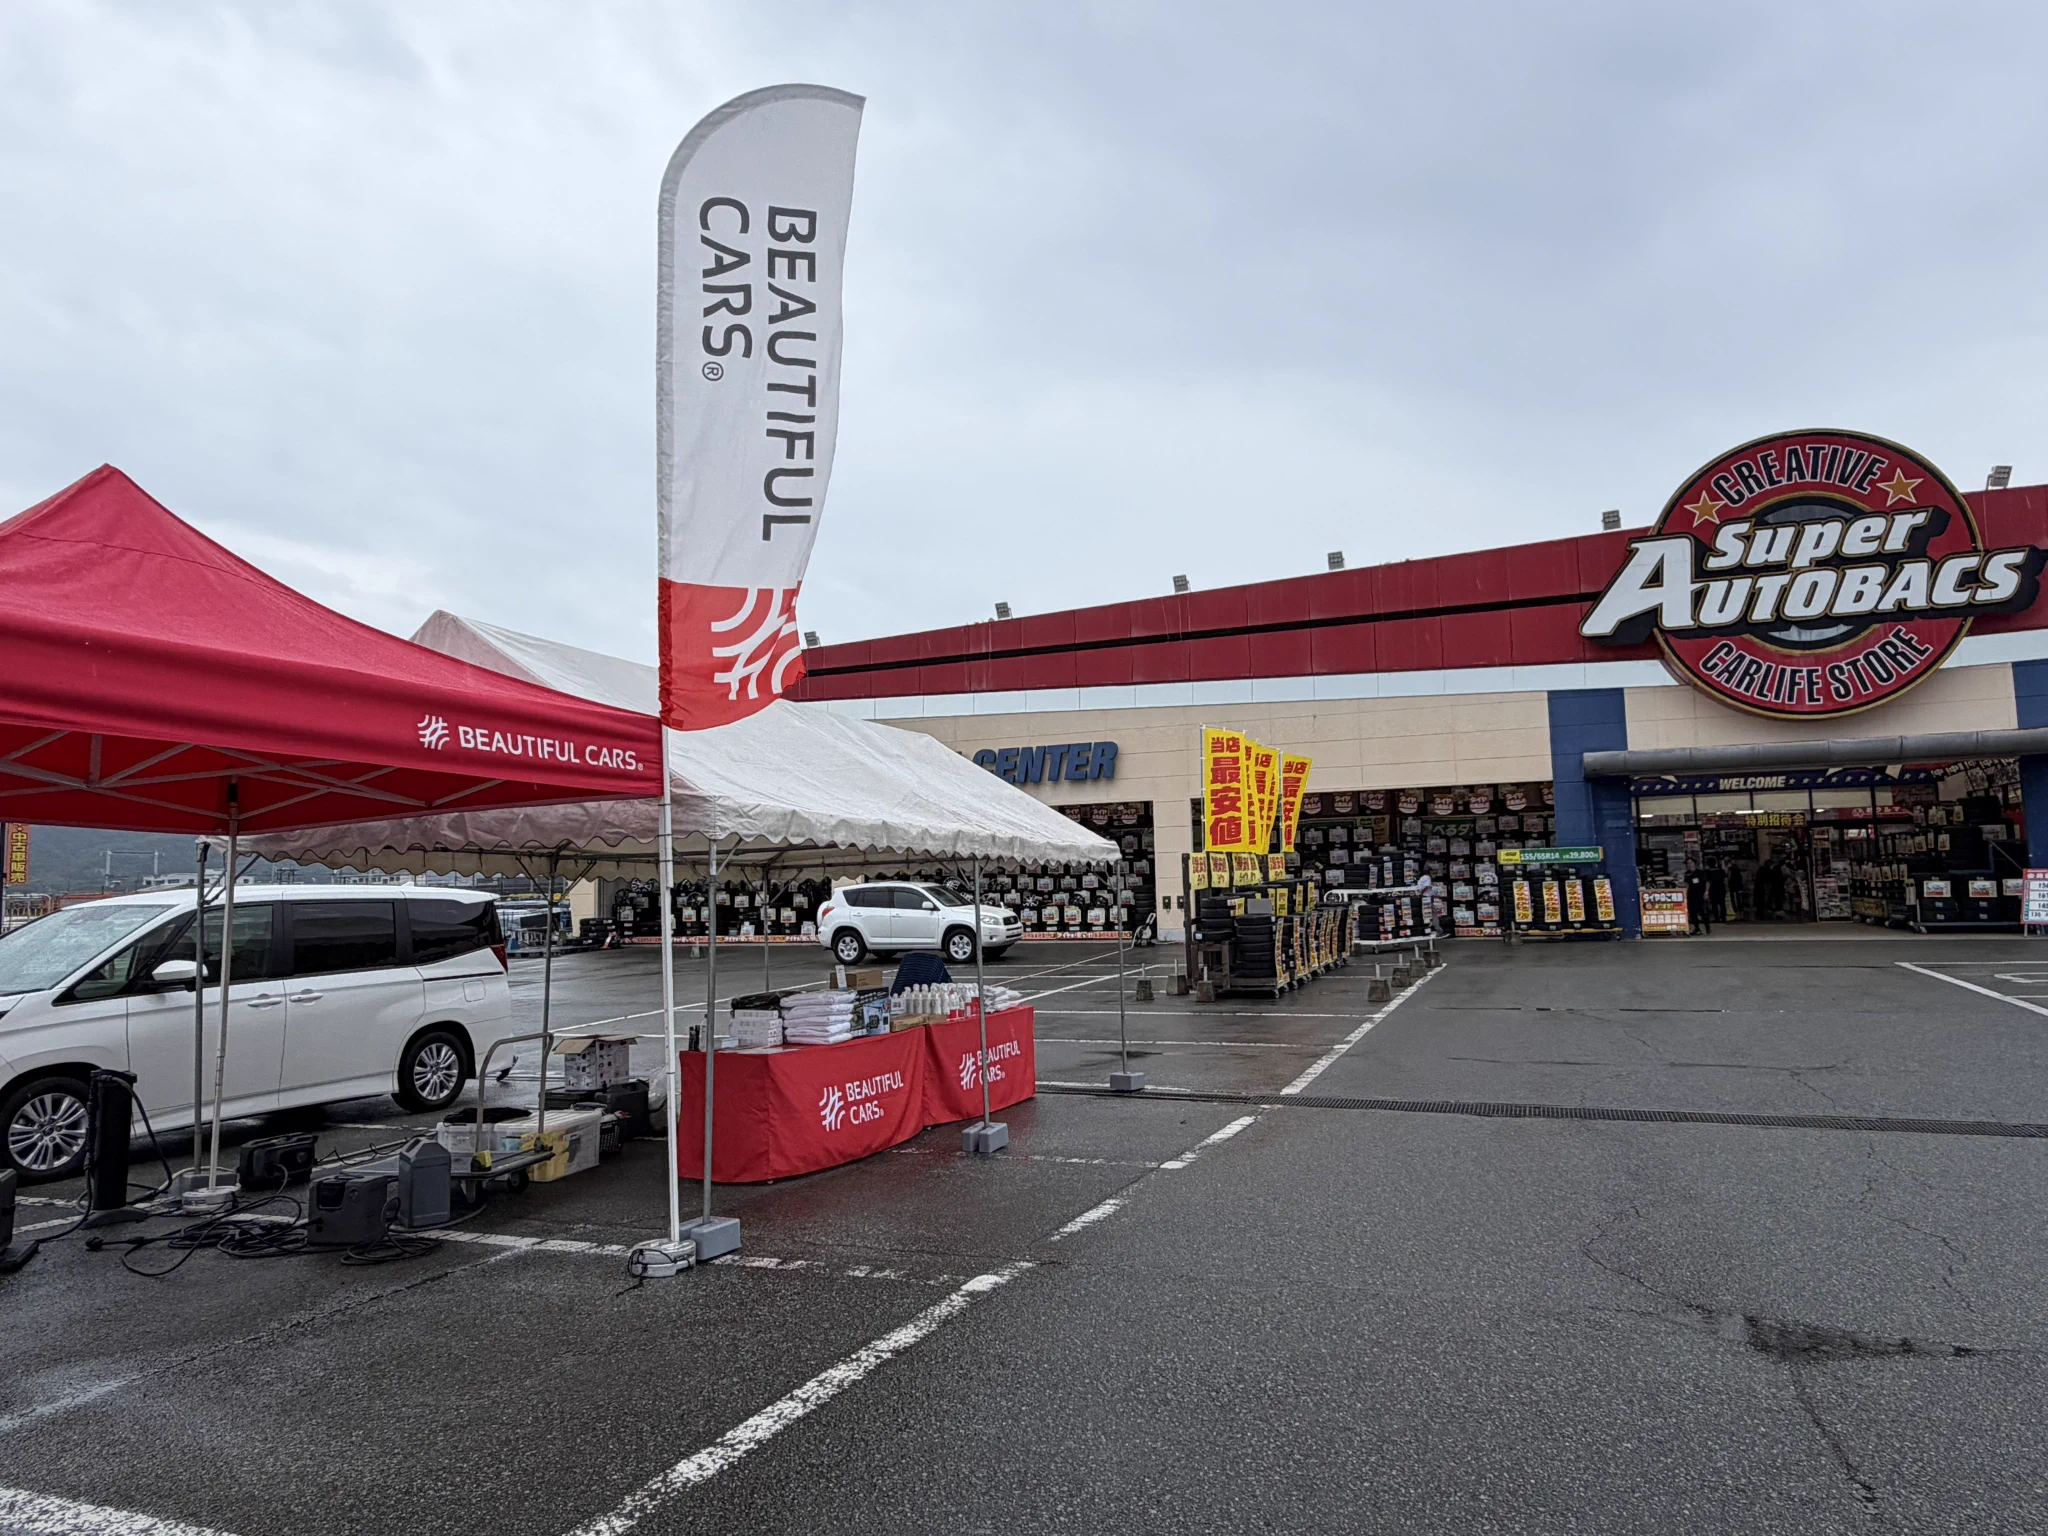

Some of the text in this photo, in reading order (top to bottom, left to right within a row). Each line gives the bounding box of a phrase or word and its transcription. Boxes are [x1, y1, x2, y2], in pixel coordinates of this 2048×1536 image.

[763, 204, 818, 542] BEAUTIFUL
[1711, 445, 1889, 506] CREATIVE
[1703, 506, 1936, 569] Super
[1580, 534, 2030, 637] AUTOBACS
[1699, 625, 1933, 704] CARLIFE STORE
[458, 726, 581, 764] BEAUTIFUL
[1211, 736, 1240, 753] 当店
[1283, 761, 1307, 774] 当店
[1210, 756, 1242, 846] 最安値
[1719, 776, 1787, 790] WELCOME
[10, 832, 27, 883] 中古車販売
[977, 1040, 1021, 1066] BAUTIFUL
[845, 1070, 905, 1102] BEAUTIFUL
